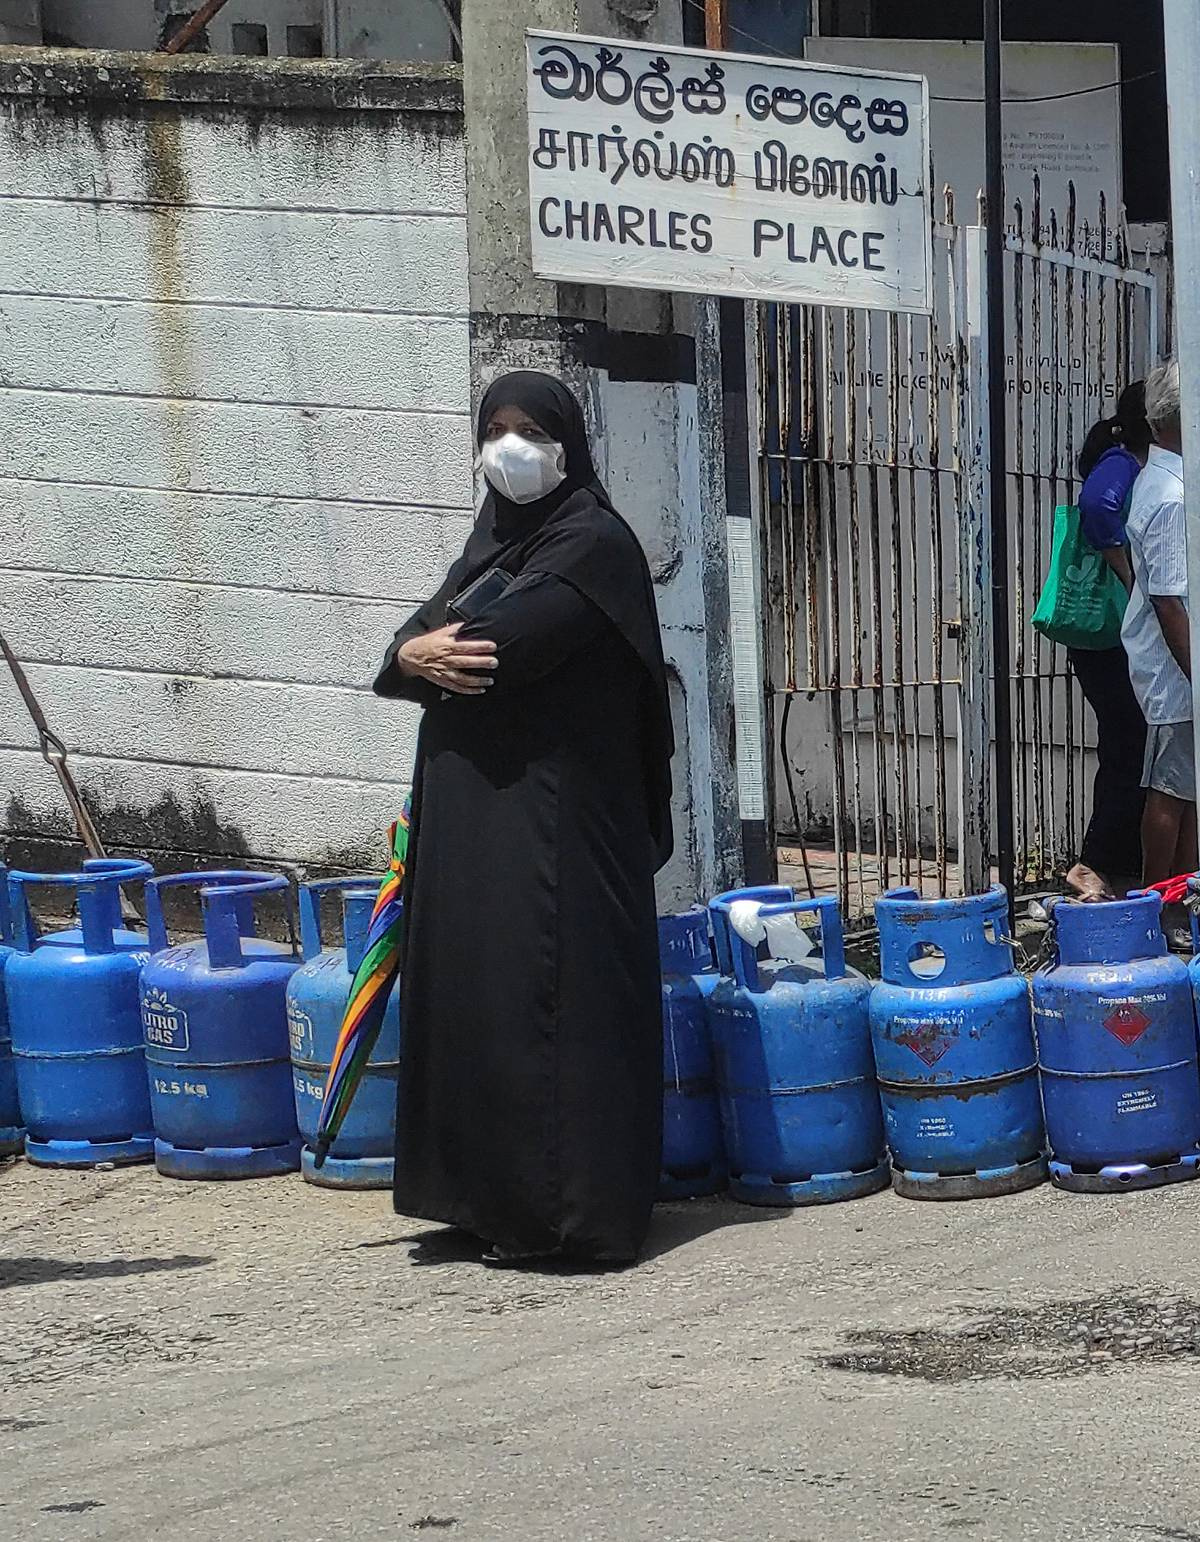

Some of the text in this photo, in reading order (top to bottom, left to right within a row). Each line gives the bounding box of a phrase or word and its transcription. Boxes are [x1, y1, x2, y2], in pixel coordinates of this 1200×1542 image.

[746, 84, 909, 144] පෙදෙස
[538, 197, 886, 272] CHARLES PLACE
[147, 1027, 174, 1044] GAS
[154, 1079, 209, 1099] 12.5 kg
[306, 1081, 324, 1100] kg
